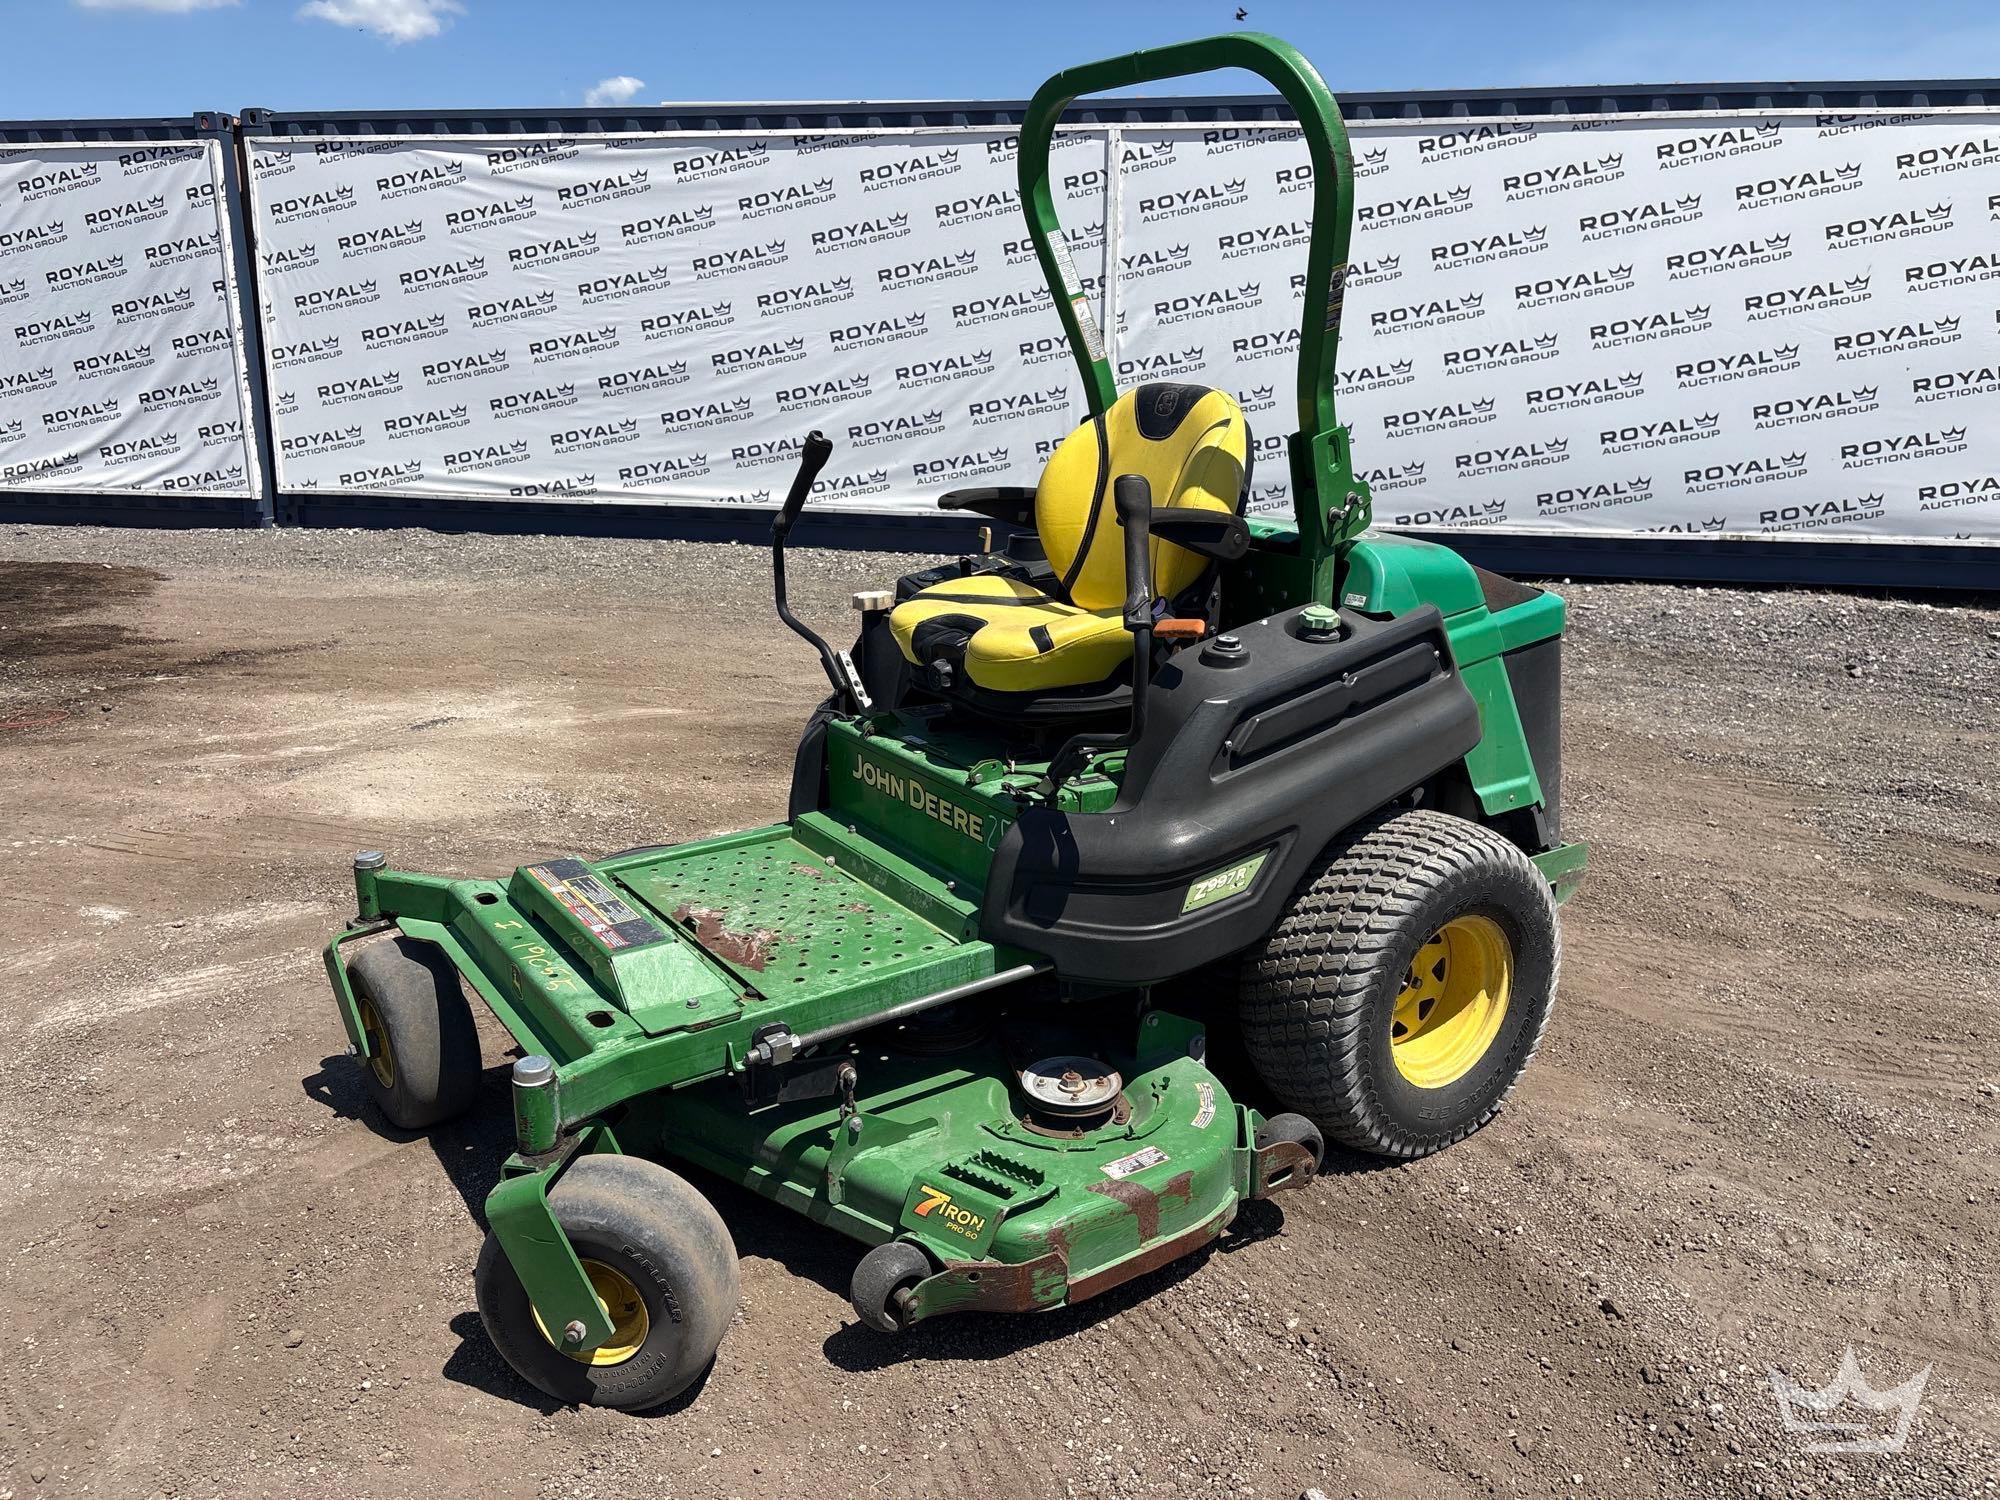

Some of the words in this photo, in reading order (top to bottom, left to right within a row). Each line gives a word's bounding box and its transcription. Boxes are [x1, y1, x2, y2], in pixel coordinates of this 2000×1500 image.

[376, 166, 446, 192] ROYAL
[860, 155, 939, 183] ROYAL
[864, 174, 917, 193] AUCTION
[918, 165, 961, 180] GROUP
[1503, 161, 1598, 192] ROYAL
[381, 184, 427, 201] AUCTION
[429, 175, 467, 190] GROUP
[557, 175, 630, 201] ROYAL
[562, 193, 611, 211] AUCTION
[612, 184, 651, 199] GROUP
[738, 184, 814, 211] ROYAL
[1506, 182, 1570, 202] AUCTION
[1573, 171, 1625, 188] GROUP
[1736, 170, 1835, 200] ROYAL
[1738, 191, 1806, 211] AUCTION
[1809, 180, 1863, 197] GROUP
[270, 191, 339, 216] ROYAL
[275, 209, 320, 225] AUCTION
[321, 200, 357, 214] GROUP
[742, 202, 793, 220] AUCTION
[795, 193, 836, 208] GROUP
[1139, 185, 1224, 214] ROYAL
[1142, 205, 1200, 224] AUCTION
[1202, 195, 1248, 211] GROUP
[1358, 193, 1448, 222] ROYAL
[84, 201, 149, 226] ROYAL
[90, 218, 133, 235] AUCTION
[133, 209, 168, 224] GROUP
[1360, 213, 1421, 232] AUCTION
[1424, 202, 1473, 219] GROUP
[1579, 201, 1676, 232] ROYAL
[1582, 222, 1647, 243] AUCTION
[1650, 211, 1703, 229] GROUP
[1825, 210, 1926, 240] ROYAL
[338, 225, 406, 250] ROYAL
[342, 243, 388, 259] AUCTION
[389, 235, 426, 248] GROUP
[1431, 232, 1523, 261] ROYAL
[1827, 231, 1896, 251] AUCTION
[1899, 221, 1954, 238] GROUP
[692, 246, 767, 272] ROYAL
[696, 264, 746, 281] AUCTION
[748, 255, 789, 270] GROUP
[1434, 253, 1496, 272] AUCTION
[1499, 243, 1549, 259] GROUP
[1666, 240, 1765, 270] ROYAL
[1669, 261, 1735, 281] AUCTION
[1739, 251, 1792, 267] GROUP
[877, 256, 956, 283] ROYAL
[881, 275, 934, 292] AUCTION
[936, 265, 978, 281] GROUP
[1515, 271, 1608, 299] ROYAL
[1517, 291, 1581, 310] AUCTION
[1584, 281, 1635, 297] GROUP
[1745, 282, 1844, 311] ROYAL
[111, 293, 176, 317] ROYAL
[116, 309, 160, 325] AUCTION
[160, 301, 195, 315] GROUP
[467, 296, 537, 320] ROYAL
[1154, 289, 1239, 316] ROYAL
[1157, 308, 1214, 326] AUCTION
[1216, 298, 1262, 314] GROUP
[1371, 299, 1460, 326] ROYAL
[1747, 303, 1815, 322] AUCTION
[1818, 293, 1872, 309] GROUP
[472, 313, 519, 329] AUCTION
[520, 305, 558, 319] GROUP
[1373, 318, 1434, 336] AUCTION
[1436, 309, 1485, 325] GROUP
[1590, 311, 1685, 340] ROYAL
[529, 331, 600, 355] ROYAL
[1592, 332, 1657, 350] AUCTION
[1660, 322, 1712, 338] GROUP
[1834, 322, 1934, 351] ROYAL
[1836, 343, 1904, 362] AUCTION
[1907, 333, 1962, 349] GROUP
[73, 350, 136, 372] ROYAL
[533, 349, 580, 364] AUCTION
[582, 340, 620, 354] GROUP
[1443, 339, 1534, 366] ROYAL
[1446, 359, 1507, 376] AUCTION
[1510, 350, 1559, 365] GROUP
[1676, 350, 1773, 379] ROYAL
[79, 366, 121, 381] AUCTION
[121, 358, 155, 371] GROUP
[895, 355, 973, 381] ROYAL
[899, 374, 951, 390] AUCTION
[953, 365, 995, 380] GROUP
[1678, 371, 1744, 389] AUCTION
[1747, 361, 1801, 377] GROUP
[138, 382, 203, 405] ROYAL
[143, 398, 186, 413] AUCTION
[187, 391, 222, 404] GROUP
[969, 392, 1047, 417] ROYAL
[1526, 378, 1618, 405] ROYAL
[1529, 397, 1591, 415] AUCTION
[1594, 388, 1644, 404] GROUP
[972, 410, 1025, 426] AUCTION
[1027, 402, 1070, 416] GROUP
[1383, 403, 1472, 429] ROYAL
[1753, 392, 1852, 420] ROYAL
[1755, 412, 1822, 430] AUCTION
[1825, 403, 1879, 418] GROUP
[848, 415, 924, 439] ROYAL
[852, 433, 903, 448] AUCTION
[904, 425, 945, 439] GROUP
[1386, 422, 1446, 439] AUCTION
[1448, 413, 1497, 428] GROUP
[1600, 419, 1694, 445] ROYAL
[280, 430, 346, 451] ROYAL
[284, 446, 329, 460] AUCTION
[330, 439, 365, 451] GROUP
[1602, 438, 1666, 455] AUCTION
[1669, 429, 1720, 444] GROUP
[1841, 432, 1940, 459] ROYAL
[618, 458, 690, 480] ROYAL
[913, 453, 989, 476] ROYAL
[1455, 443, 1545, 469] ROYAL
[1458, 462, 1518, 478] AUCTION
[1521, 454, 1570, 468] GROUP
[1842, 452, 1911, 470] AUCTION
[1913, 443, 1968, 458] GROUP
[623, 475, 671, 488] AUCTION
[672, 467, 710, 480] GROUP
[917, 470, 968, 485] AUCTION
[970, 462, 1011, 476] GROUP
[1684, 458, 1780, 484] ROYAL
[1686, 477, 1752, 494] AUCTION
[1755, 468, 1808, 483] GROUP
[1536, 482, 1627, 507] ROYAL
[1539, 501, 1600, 517] AUCTION
[1603, 493, 1653, 507] GROUP
[852, 753, 905, 802] JOHN
[909, 779, 984, 843] DEERE
[1193, 867, 1247, 901] Z997R
[946, 1221, 964, 1235] PRO
[965, 1230, 978, 1241] 60
